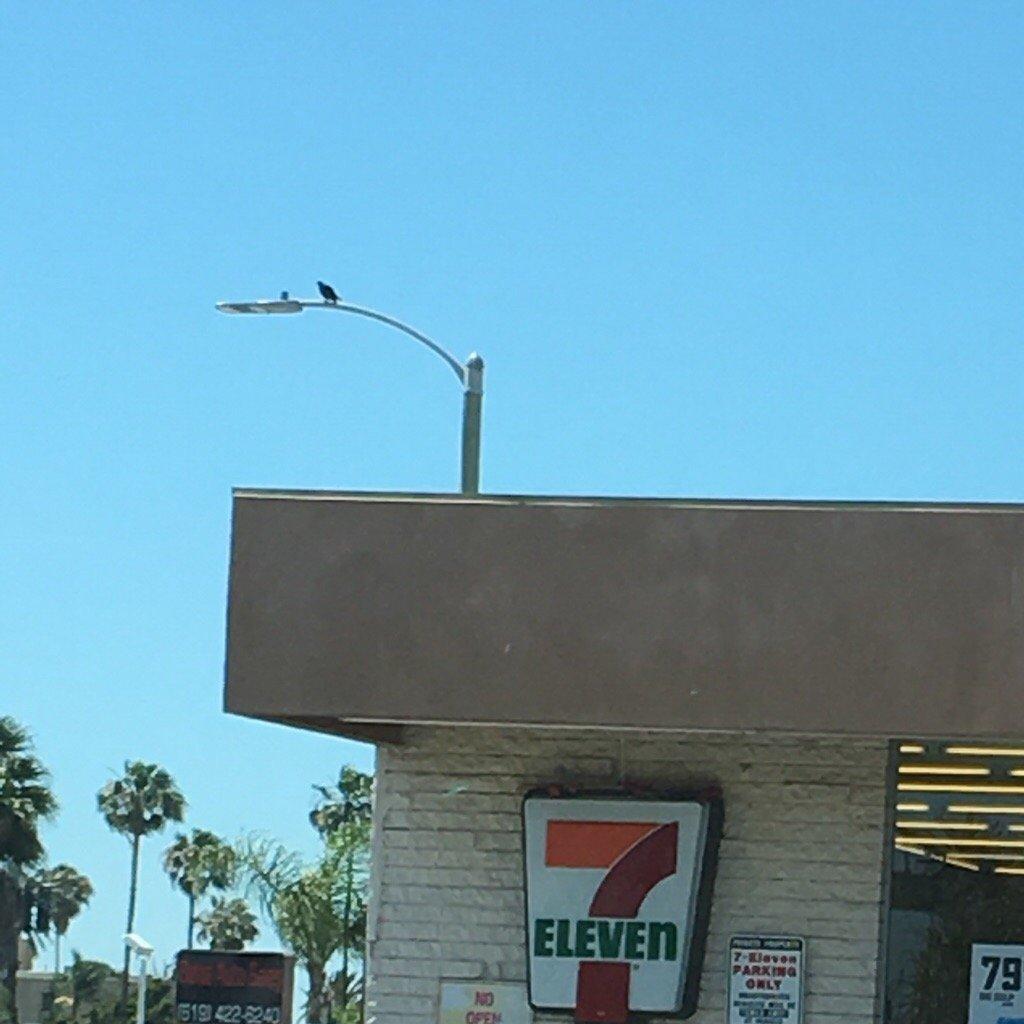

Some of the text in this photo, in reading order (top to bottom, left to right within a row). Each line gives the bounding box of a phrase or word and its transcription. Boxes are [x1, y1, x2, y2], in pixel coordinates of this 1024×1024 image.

[734, 952, 797, 964] 7-Eleven
[733, 965, 797, 977] PARKING
[746, 978, 781, 990] ONLY
[475, 991, 494, 1006] NO
